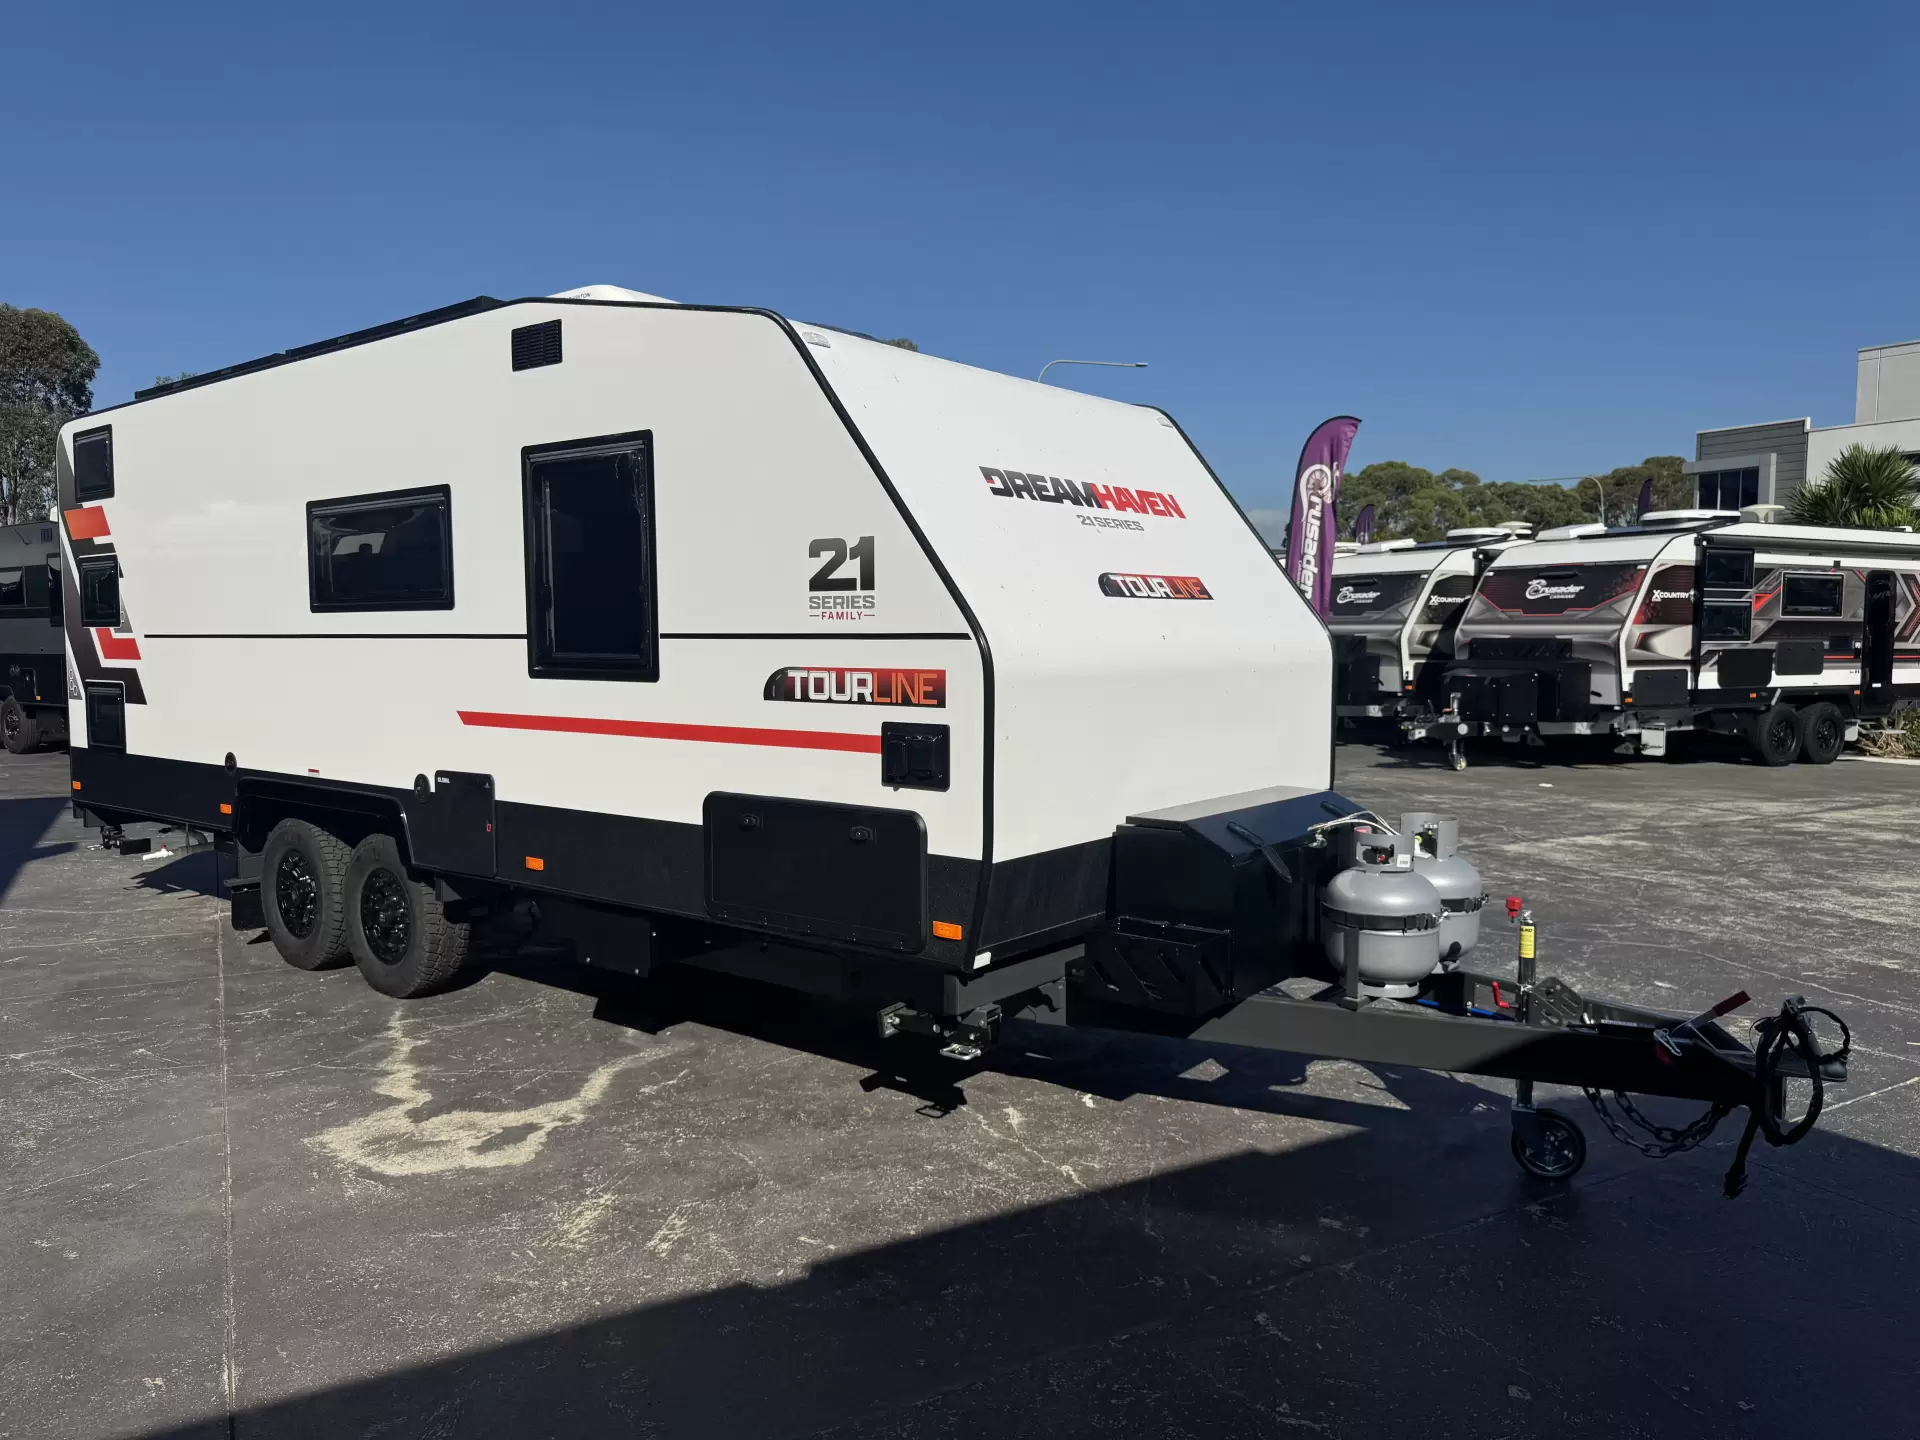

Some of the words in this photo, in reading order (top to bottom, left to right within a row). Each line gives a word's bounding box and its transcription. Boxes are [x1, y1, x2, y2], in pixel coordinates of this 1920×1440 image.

[979, 466, 1187, 519] DREAMHAVEN
[1076, 514, 1097, 527] 21
[1095, 517, 1145, 532] SERIES
[808, 536, 875, 592] 21
[1108, 574, 1209, 599] TOURLINE
[808, 595, 876, 610] SERIES
[821, 611, 863, 620] FAMILY
[787, 669, 938, 705] TOURLINE
